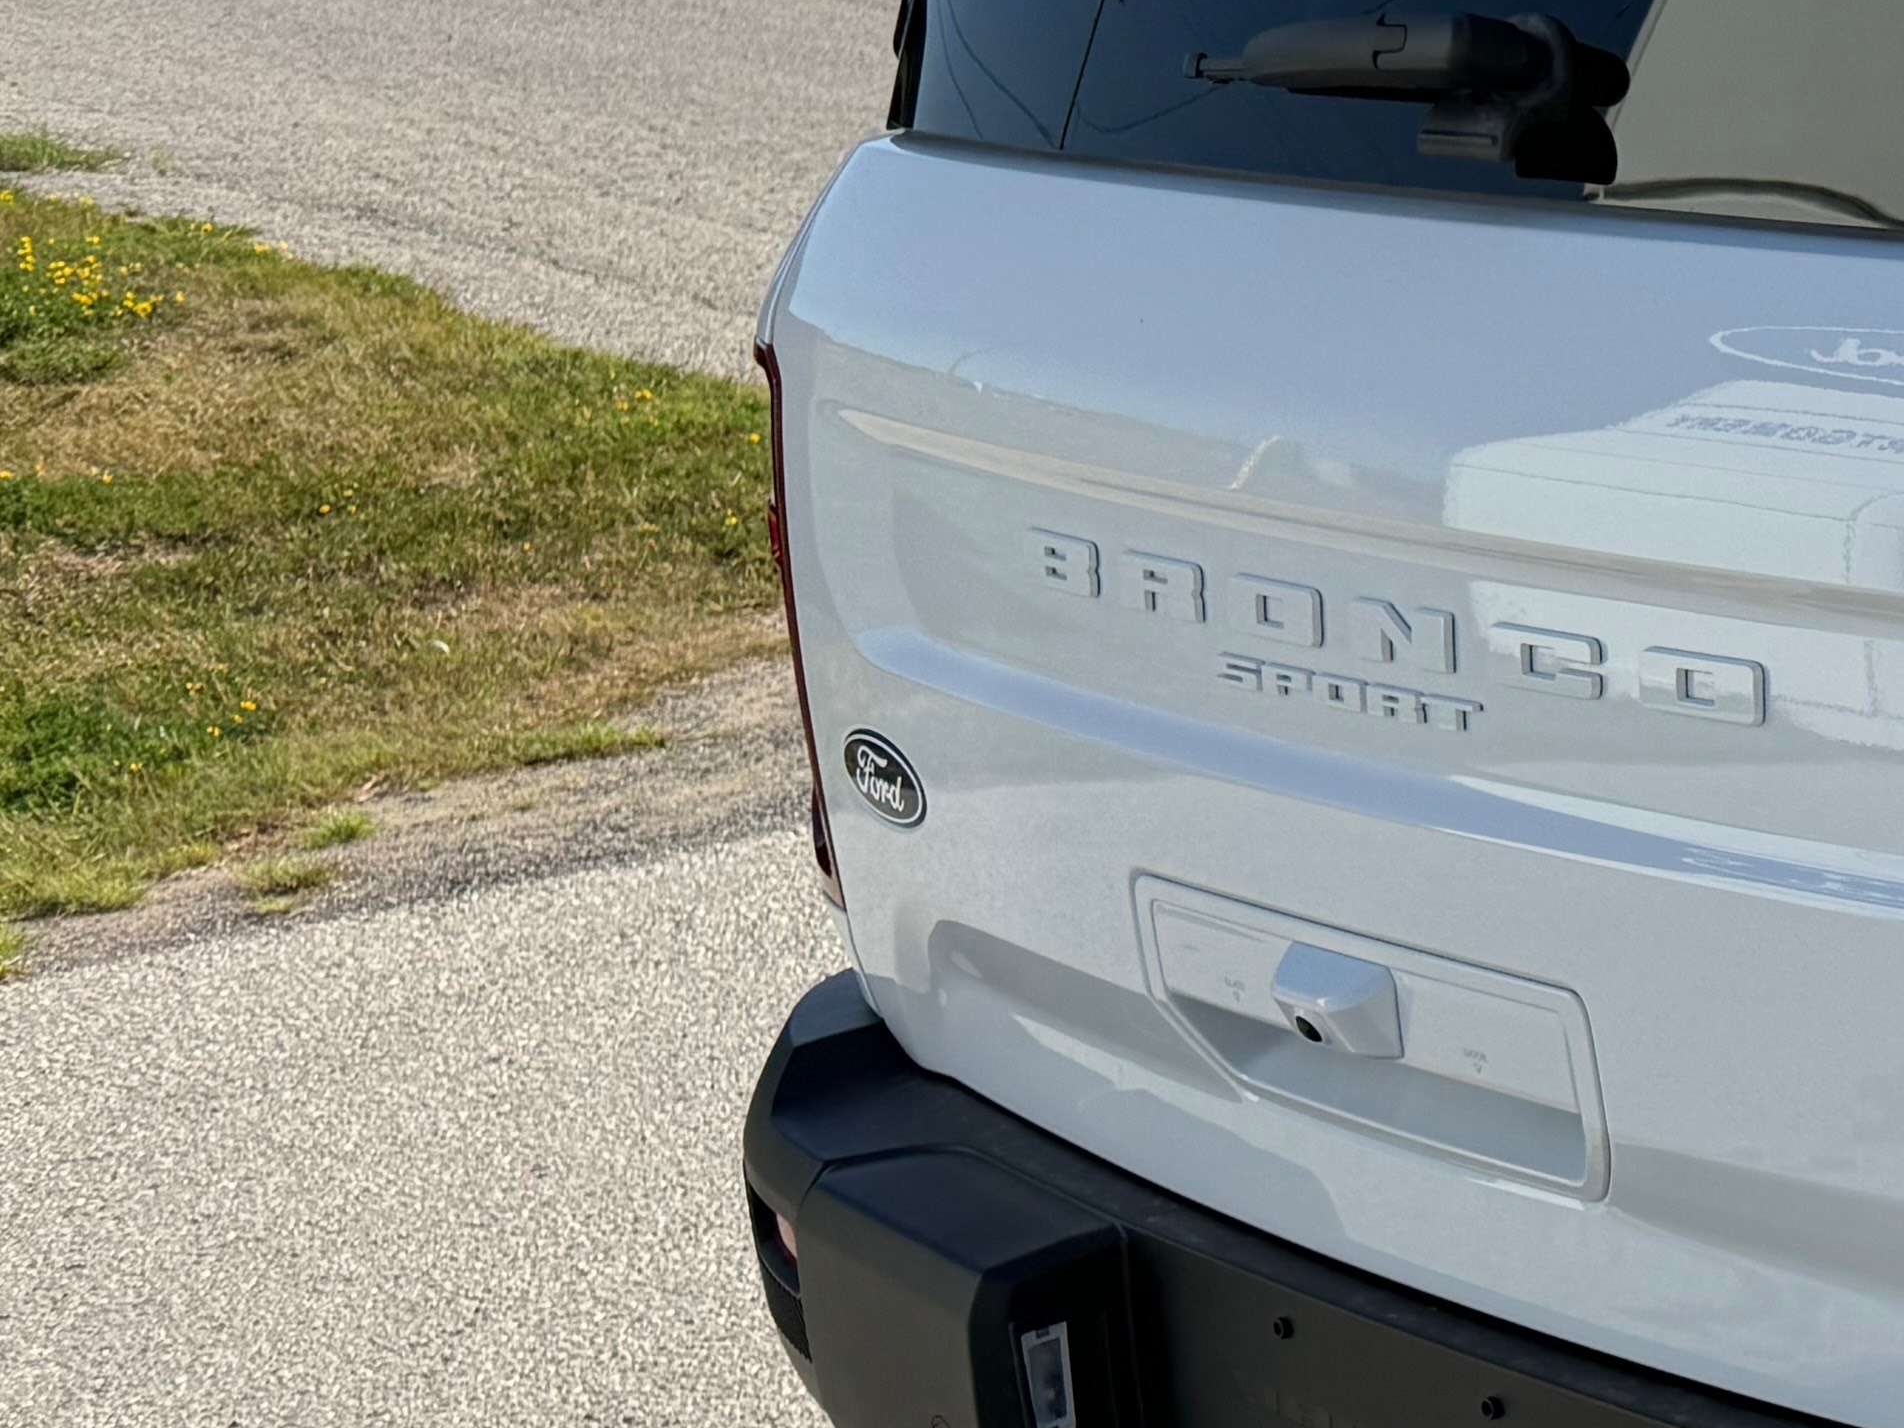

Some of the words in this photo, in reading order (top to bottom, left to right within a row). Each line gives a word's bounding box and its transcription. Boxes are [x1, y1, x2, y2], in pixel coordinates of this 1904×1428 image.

[1030, 526, 1768, 727] BRONCO
[1215, 650, 1485, 732] SPORT
[856, 745, 904, 812] Ford
